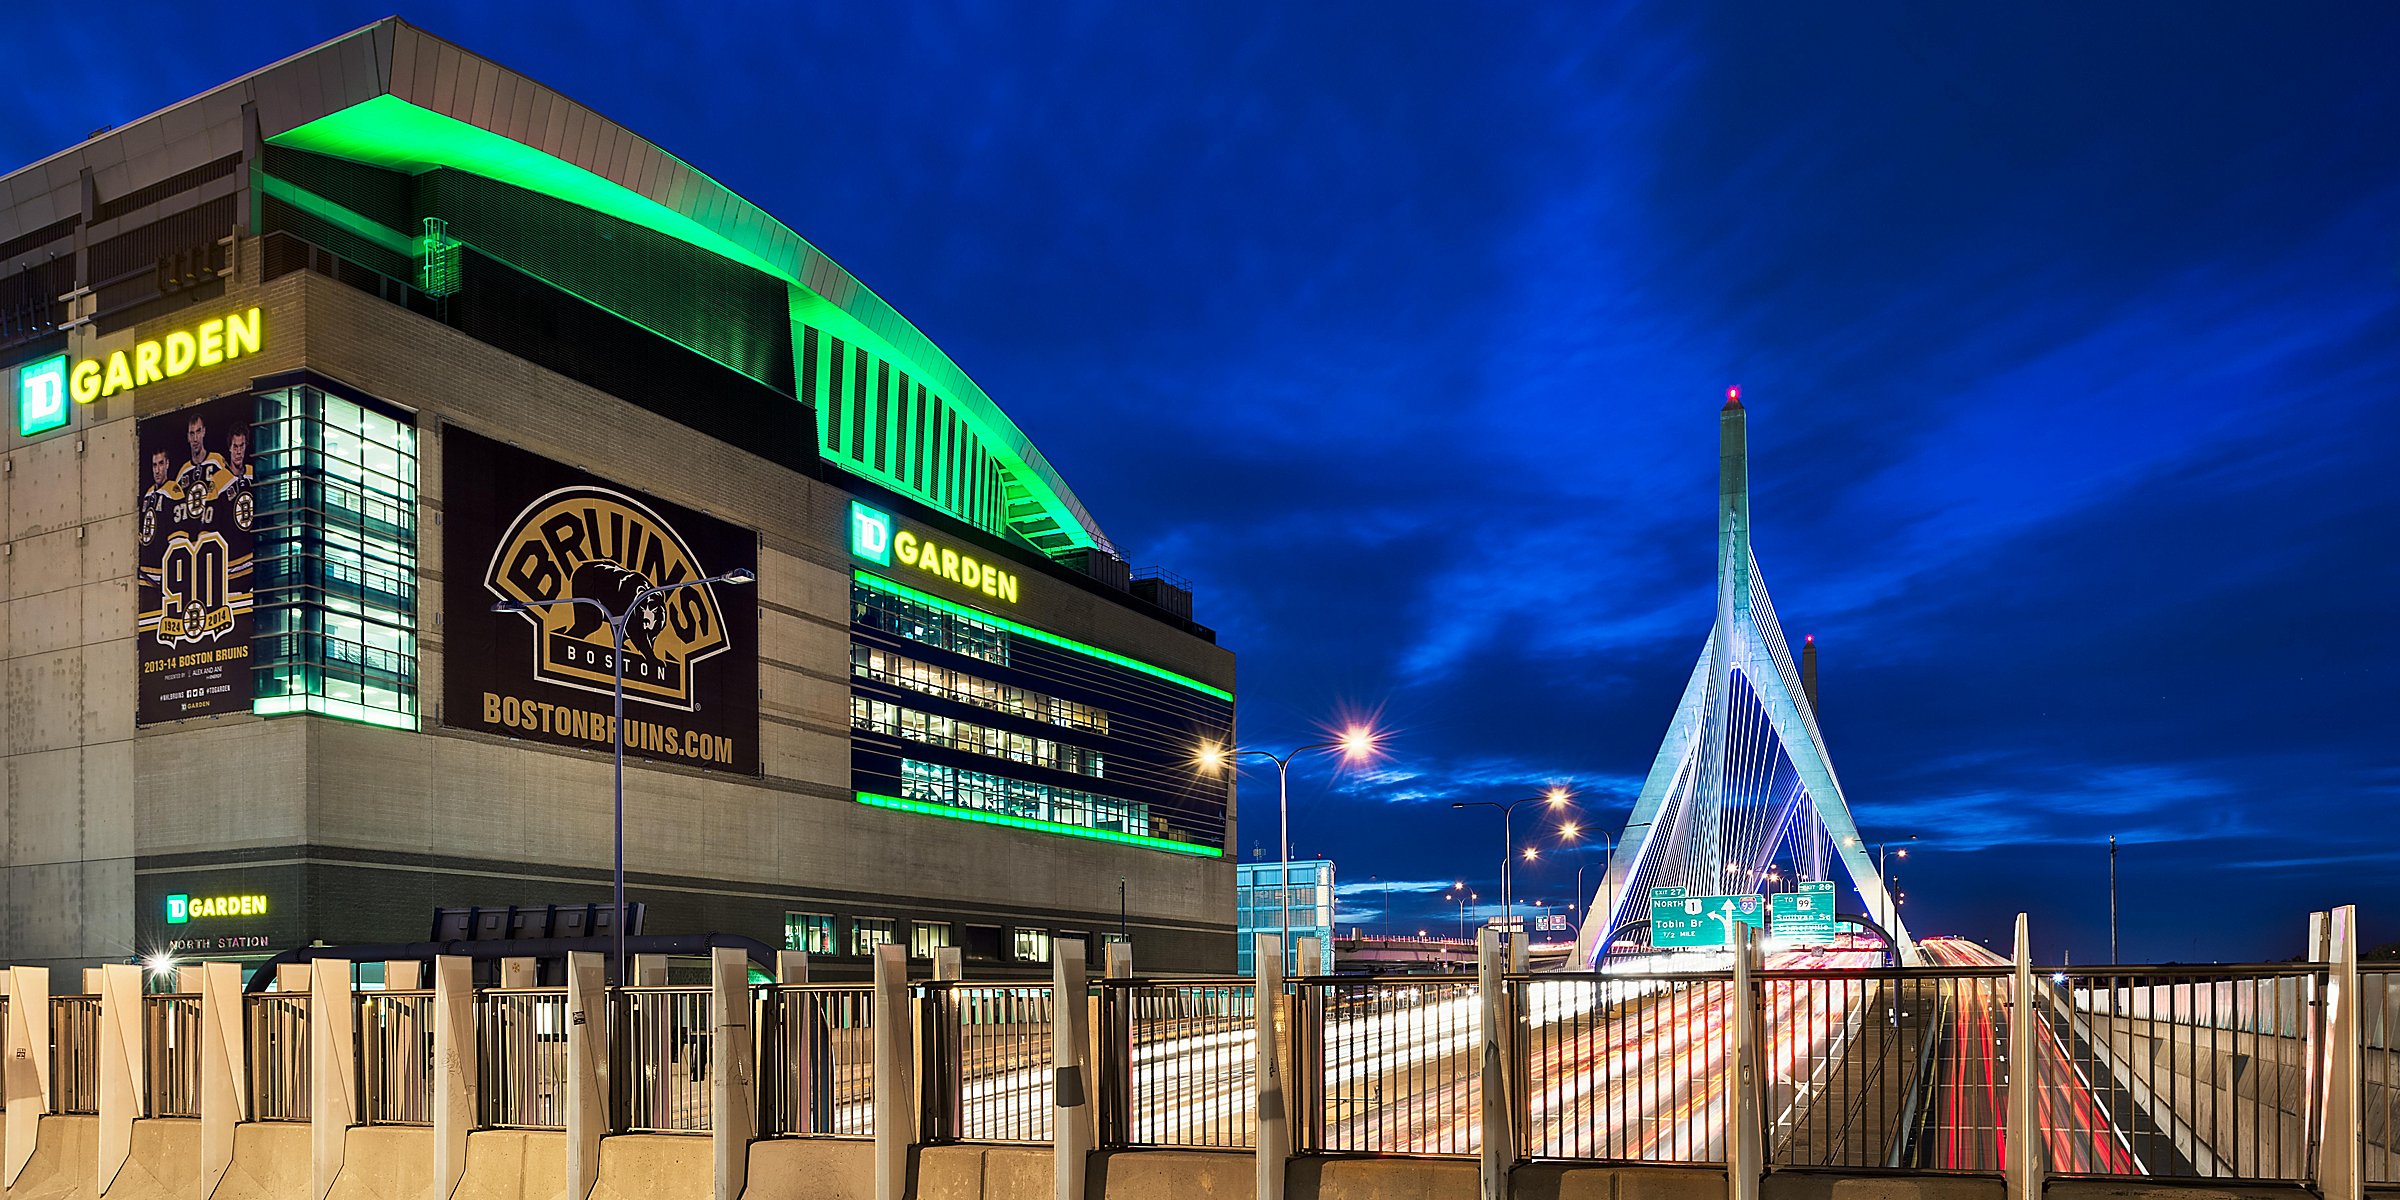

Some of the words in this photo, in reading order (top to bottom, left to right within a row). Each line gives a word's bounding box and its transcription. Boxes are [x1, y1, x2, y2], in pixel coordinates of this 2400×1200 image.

[25, 371, 62, 419] TD
[70, 307, 261, 404] GARDEN
[173, 503, 188, 523] 37
[856, 512, 886, 554] TD
[894, 530, 1018, 604] GARDEN
[162, 532, 228, 618] 90
[506, 508, 710, 645] BRUINS
[164, 620, 181, 632] 1924
[208, 609, 226, 627] 2014
[144, 658, 177, 673] 2013-14
[179, 651, 213, 668] BOSTON
[215, 645, 249, 662] BRUINS
[567, 645, 666, 681] BOSTON
[206, 685, 230, 695] #TDGARDEN
[187, 701, 210, 710] GARDEN
[483, 691, 733, 764] BOSTONBRUINS.COM
[169, 899, 186, 918] TD
[189, 895, 267, 917] GARDEN
[1654, 900, 1684, 908] NORTH
[1741, 902, 1754, 910] 93
[1656, 920, 1685, 928] Tobin
[1690, 919, 1703, 928] Br
[169, 938, 210, 950] NORTH
[218, 936, 269, 949] STATION
